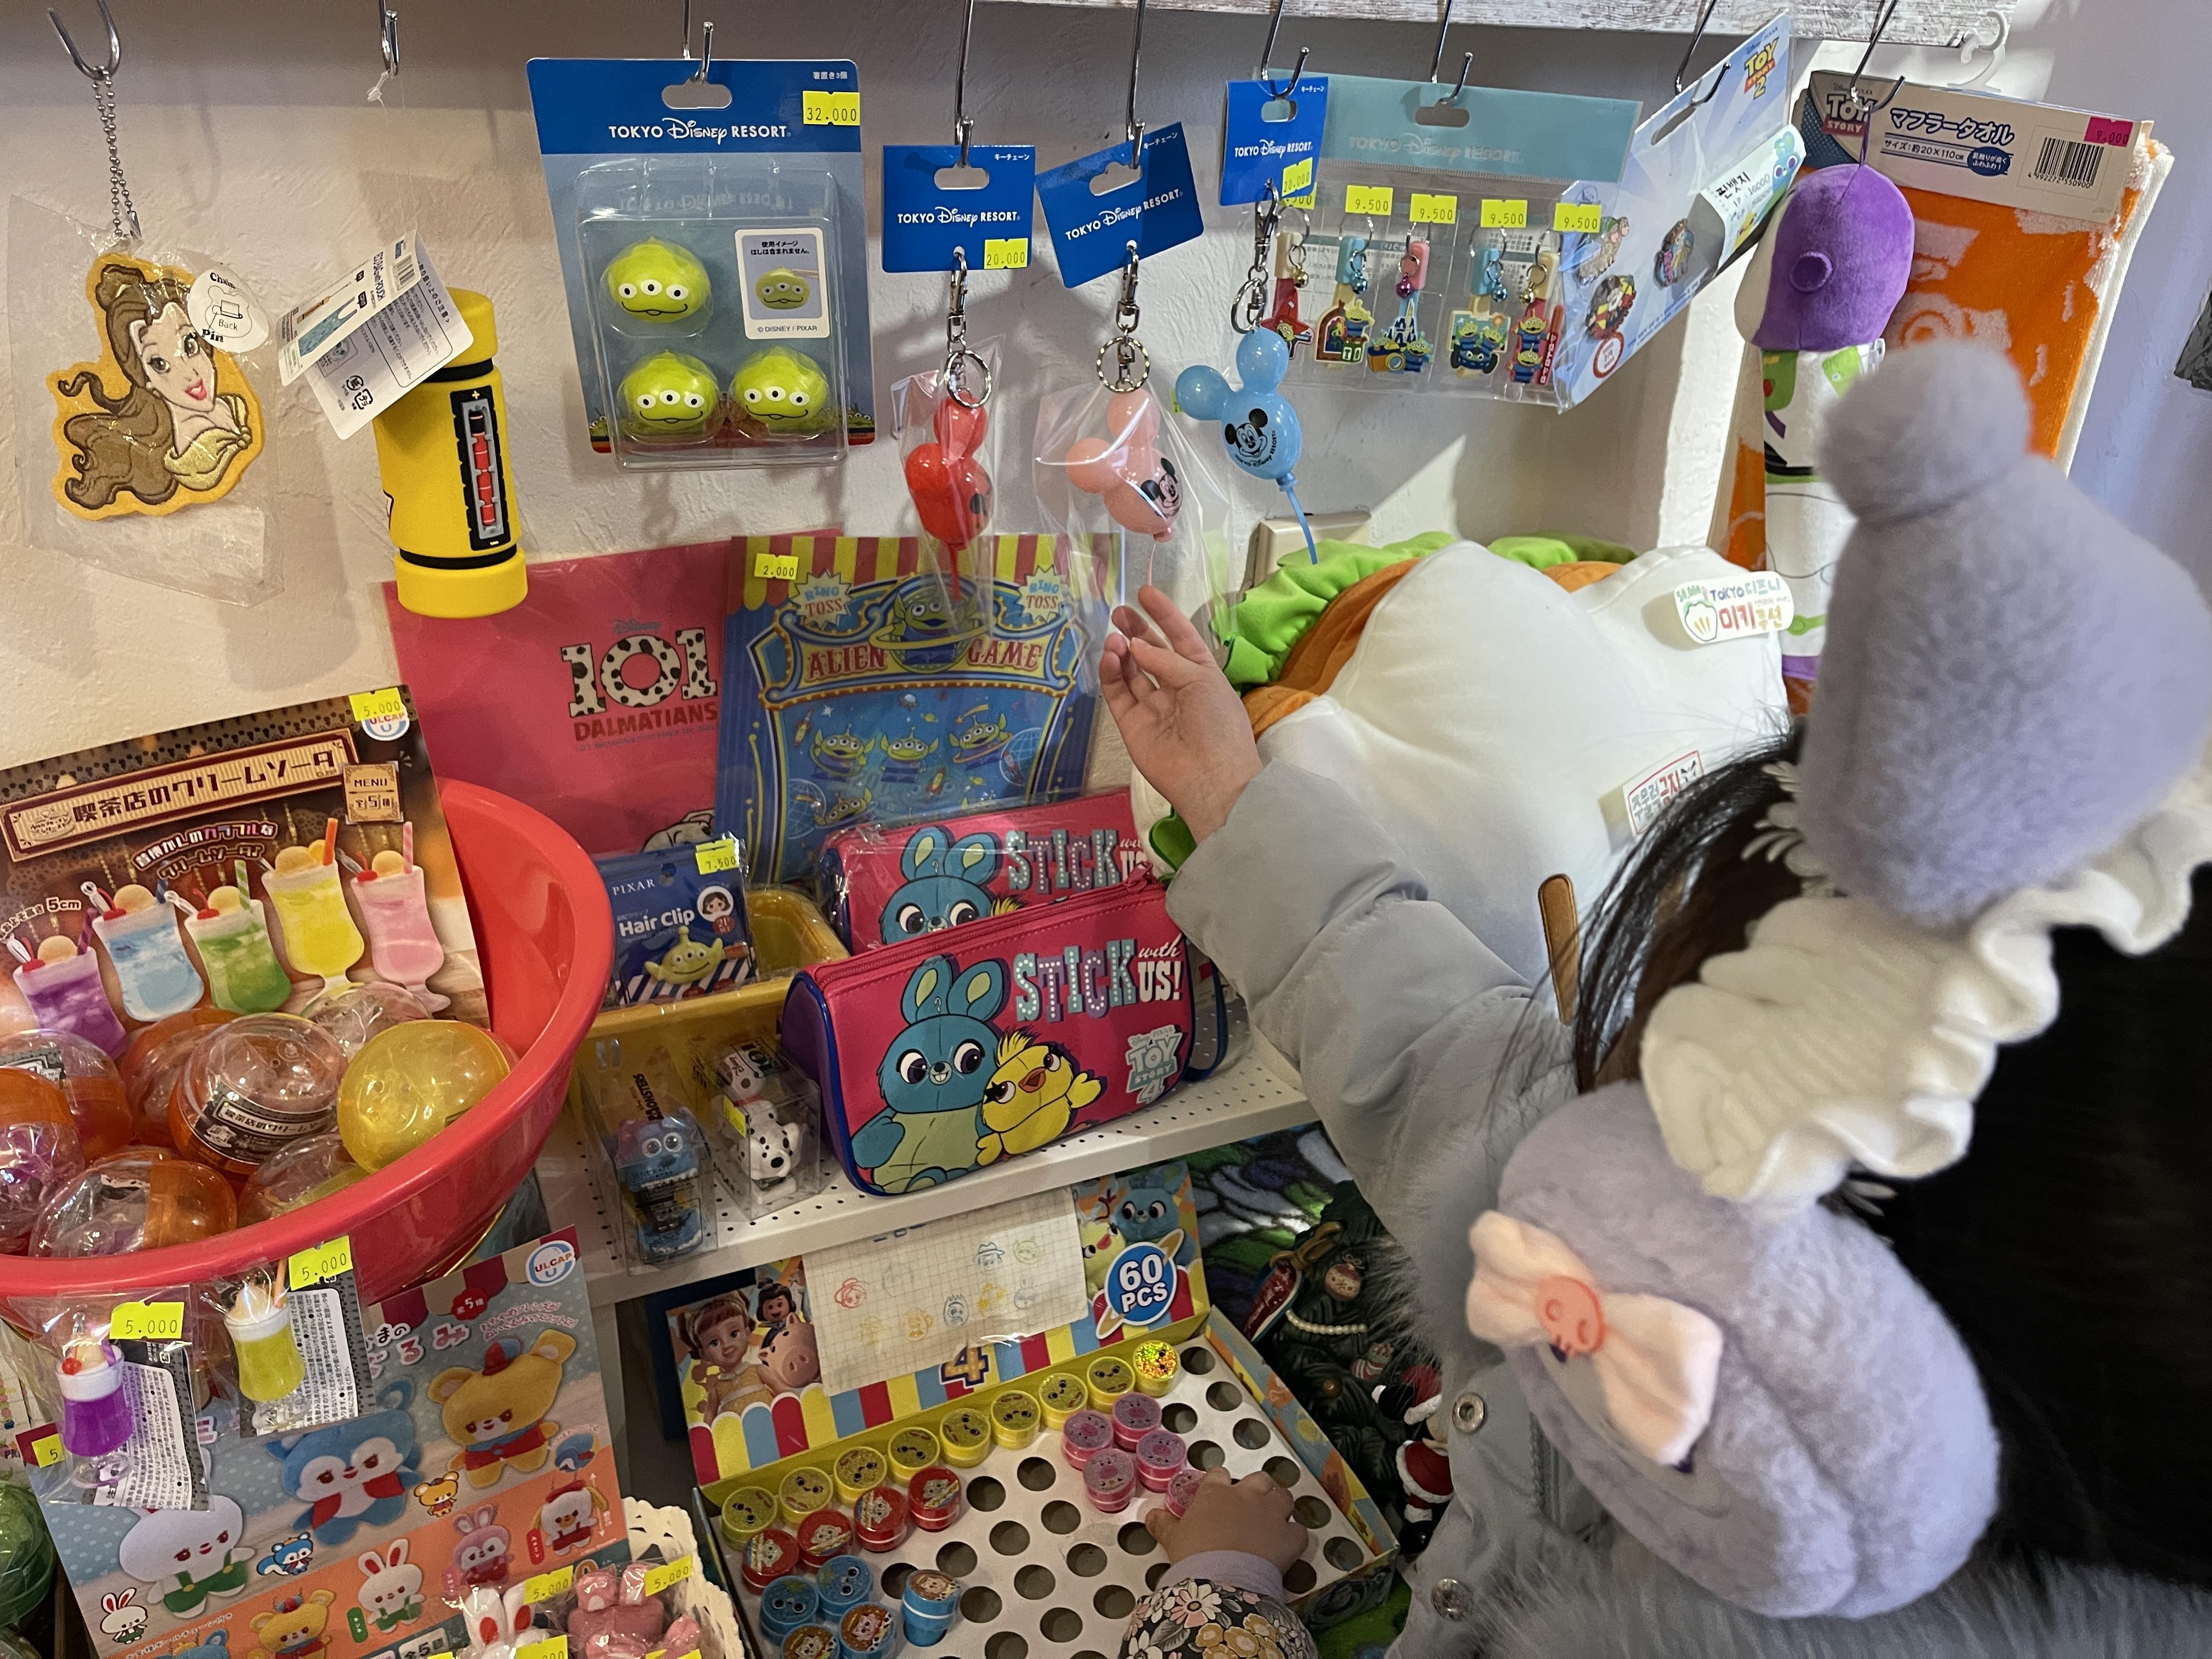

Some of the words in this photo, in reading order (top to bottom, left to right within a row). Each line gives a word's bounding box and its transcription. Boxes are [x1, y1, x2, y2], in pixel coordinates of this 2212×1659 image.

[1744, 38, 1780, 76] TOY
[1753, 75, 1767, 100] 2
[807, 106, 857, 122] 32.000
[609, 126, 663, 138] TOKYO
[662, 118, 727, 145] Disney
[731, 125, 787, 138] RESORT
[1827, 120, 1863, 133] STORY
[1890, 108, 2015, 145] マフラータオル
[1234, 145, 1259, 158] TOKYO
[1259, 139, 1286, 159] Disney
[1286, 141, 1312, 153] RESORT
[1349, 136, 1402, 153] TOKYO
[1065, 221, 1101, 240] TOKYO
[1101, 205, 1143, 227] Disney
[1143, 189, 1181, 210] RESORT
[1355, 198, 1390, 211] 9.500
[1419, 208, 1454, 221] 9.500
[898, 212, 934, 224] TOKYO
[934, 206, 978, 227] Disney
[980, 211, 1017, 222] RESORT
[1490, 213, 1524, 225] 9.500
[1564, 217, 1598, 230] 9.500
[761, 240, 799, 249] 使用イメージ
[986, 251, 1026, 266] 20.000
[210, 272, 235, 289] Chain
[201, 328, 223, 343] Pin
[218, 319, 238, 331] Back
[763, 565, 796, 577] 2.000
[805, 584, 840, 601] RING
[1026, 594, 1058, 610] TOSS
[1710, 586, 1745, 601] TOKYO
[805, 598, 844, 617] TOSS
[1718, 602, 1757, 630] 미키
[808, 645, 888, 680] ALIEN
[967, 639, 1042, 669] GAME
[561, 627, 718, 718] 101
[364, 700, 400, 717] 5.000
[574, 701, 719, 741] DALMATIANS
[72, 750, 335, 823] 喫茶店のクリームソーダ
[354, 778, 388, 788] MENU
[706, 856, 737, 871] 7.500
[1005, 829, 1121, 895] STICK
[612, 879, 656, 896] PIXAR
[47, 898, 81, 911] 5cm
[619, 915, 658, 937] Hair
[661, 907, 695, 927] Clip
[1138, 936, 1179, 959] with
[1013, 938, 1138, 1024] STICK
[1138, 961, 1183, 1003] US!
[1128, 1035, 1180, 1073] TOY
[1134, 1063, 1172, 1084] STORY
[633, 1073, 665, 1121] MONSTERS
[1139, 1077, 1162, 1102] 4
[302, 1253, 348, 1280] 5.000
[535, 1252, 572, 1273] ULCAP
[1119, 1254, 1164, 1291] 60
[1120, 1283, 1167, 1312] PCS
[125, 1319, 178, 1335] 5.000
[942, 1347, 988, 1386] 4
[654, 1566, 690, 1588] 5.000
[534, 1578, 569, 1598] 5.000
